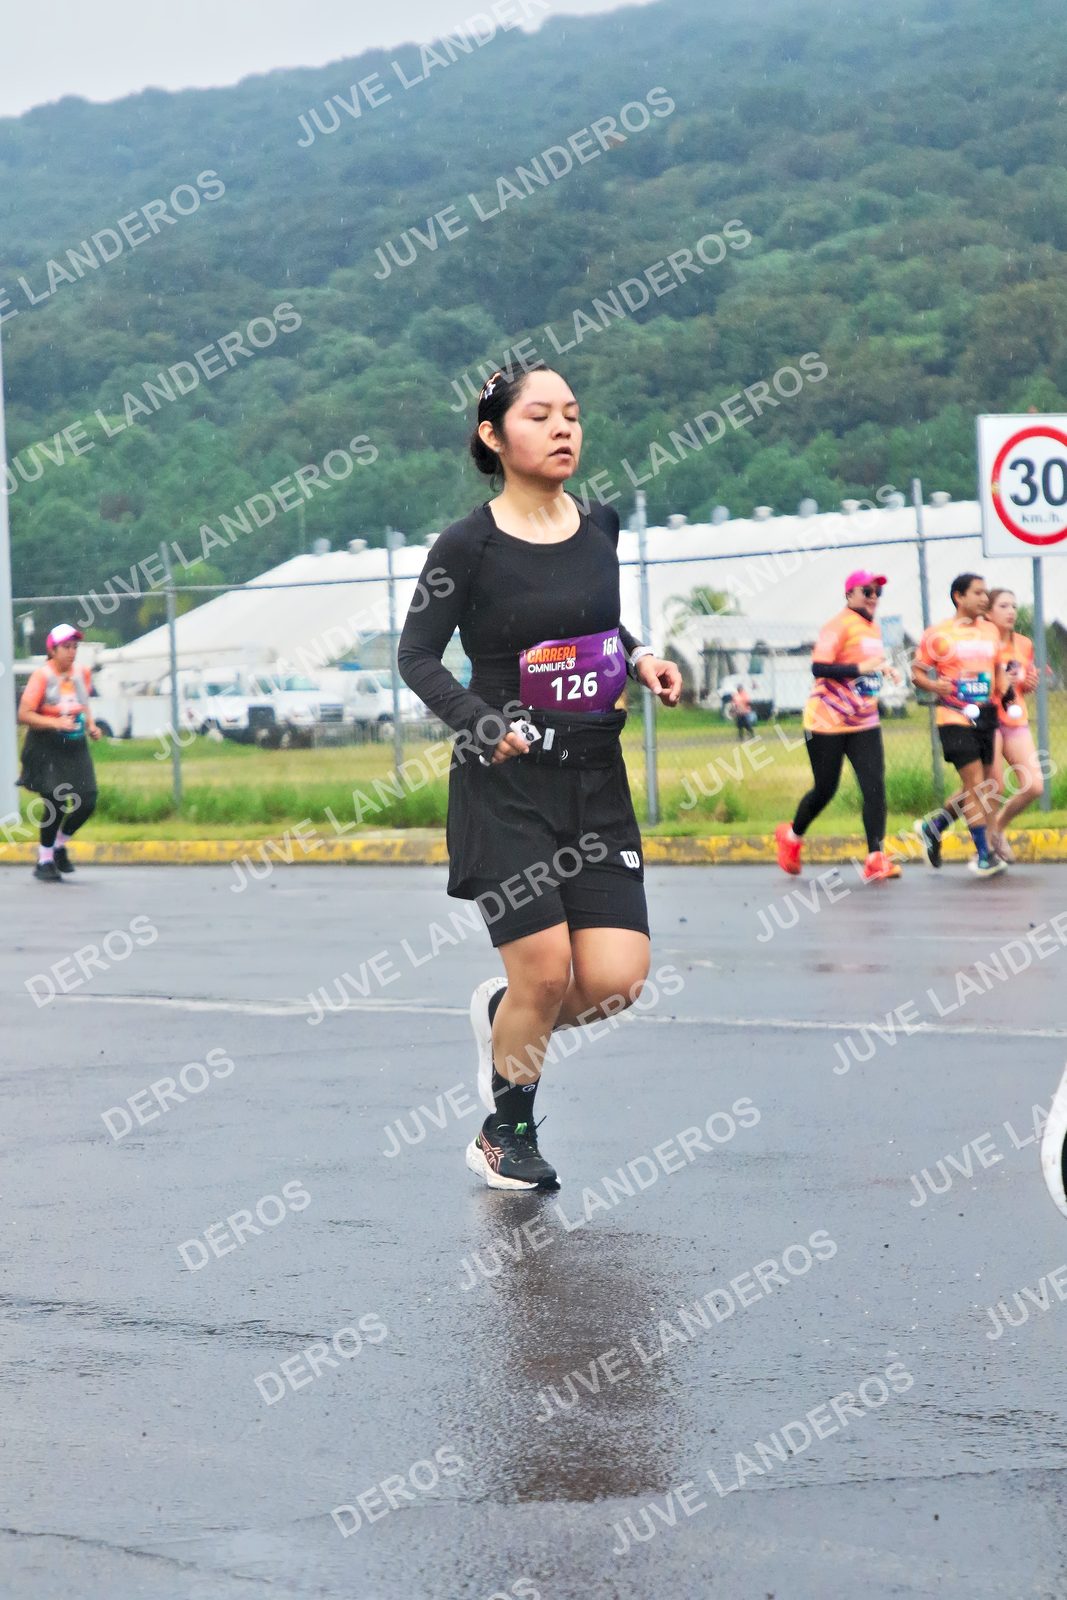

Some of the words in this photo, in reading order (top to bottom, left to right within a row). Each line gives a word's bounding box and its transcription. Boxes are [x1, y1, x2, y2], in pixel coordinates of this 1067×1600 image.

[1009, 458, 1067, 506] 30
[527, 645, 577, 664] CARRERA
[551, 672, 598, 701] 126
